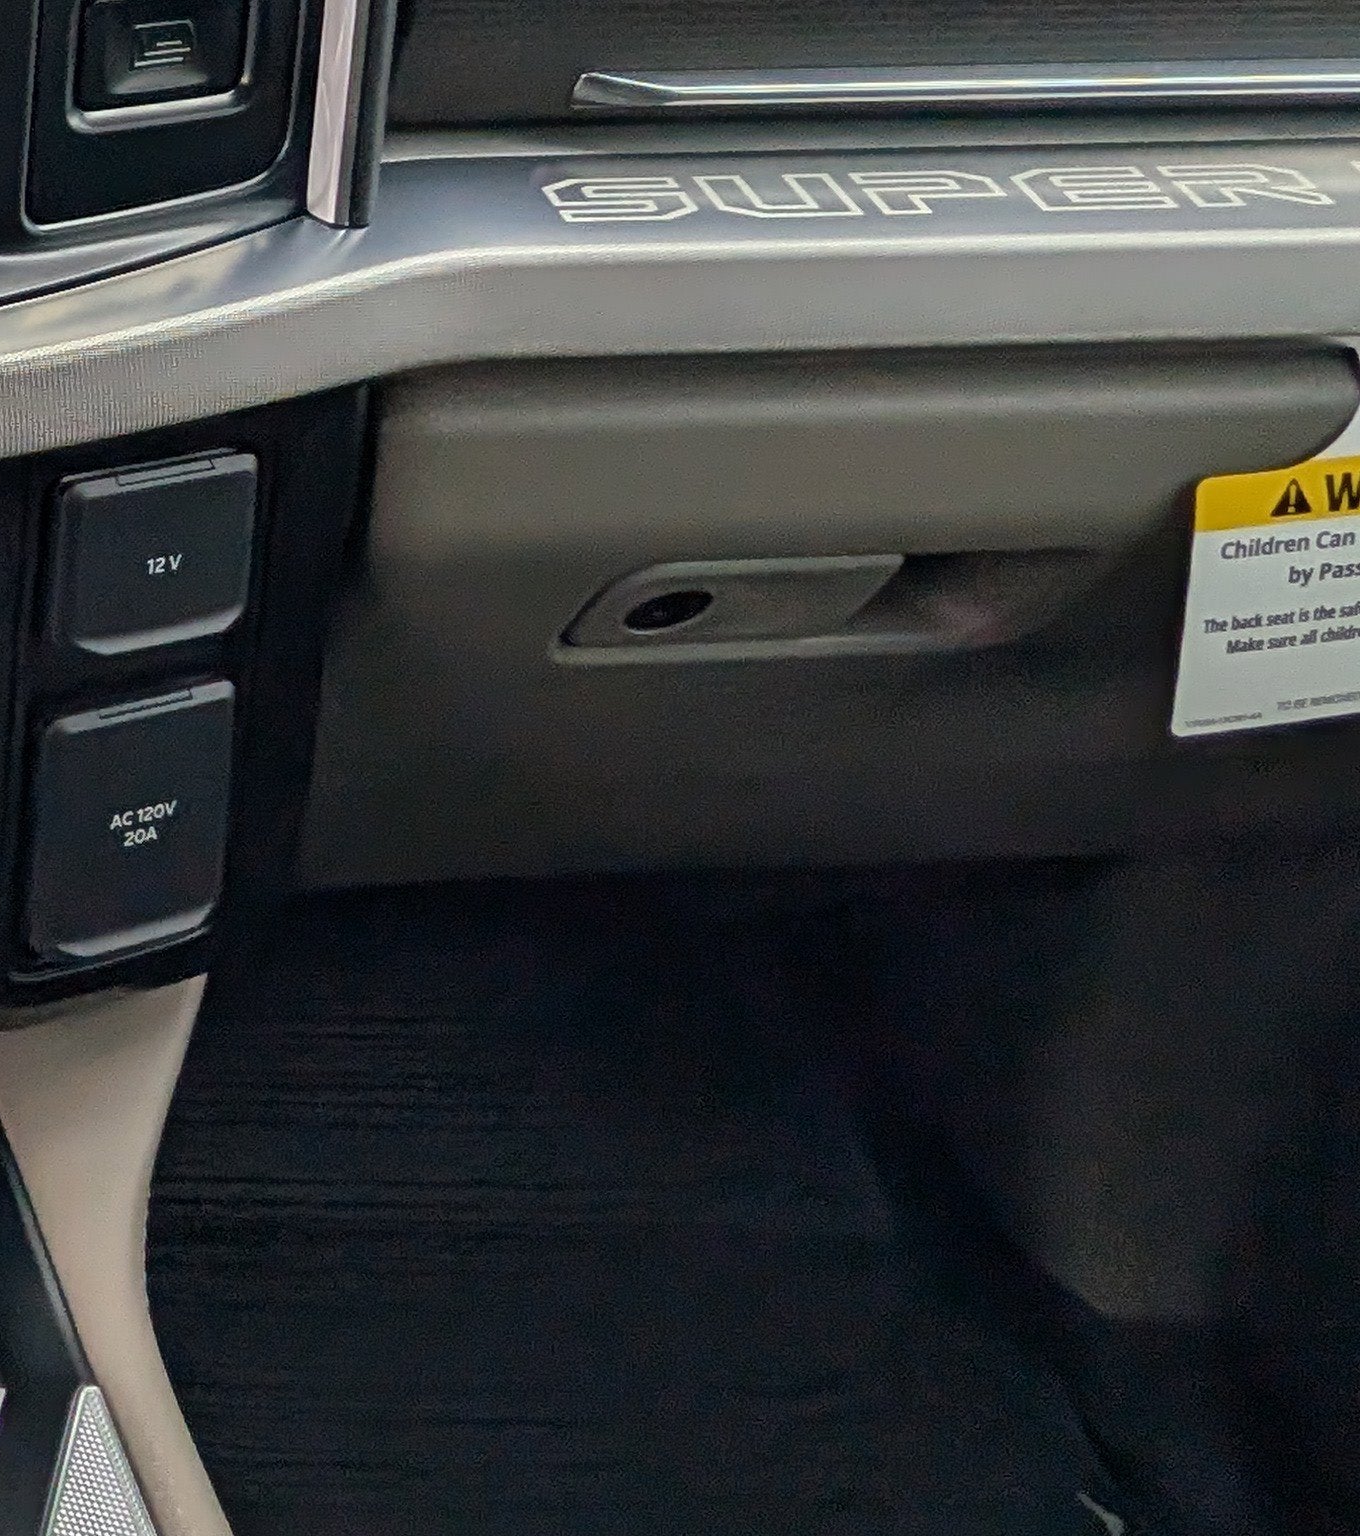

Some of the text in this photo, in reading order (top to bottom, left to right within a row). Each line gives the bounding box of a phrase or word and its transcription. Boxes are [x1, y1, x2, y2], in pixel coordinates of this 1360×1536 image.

[541, 162, 1336, 223] SUPER
[1220, 529, 1356, 561] Children Can
[146, 552, 183, 575] 12 V
[1287, 565, 1314, 587] by
[1203, 617, 1228, 634] The
[1231, 613, 1263, 631] back
[1266, 610, 1296, 627] seat
[1298, 607, 1310, 623] is
[1313, 604, 1336, 621] the
[1226, 637, 1265, 654] Make
[1267, 633, 1298, 650] sure
[1300, 628, 1318, 646] all
[109, 800, 179, 830] AC 120V
[122, 826, 159, 848] 20A
